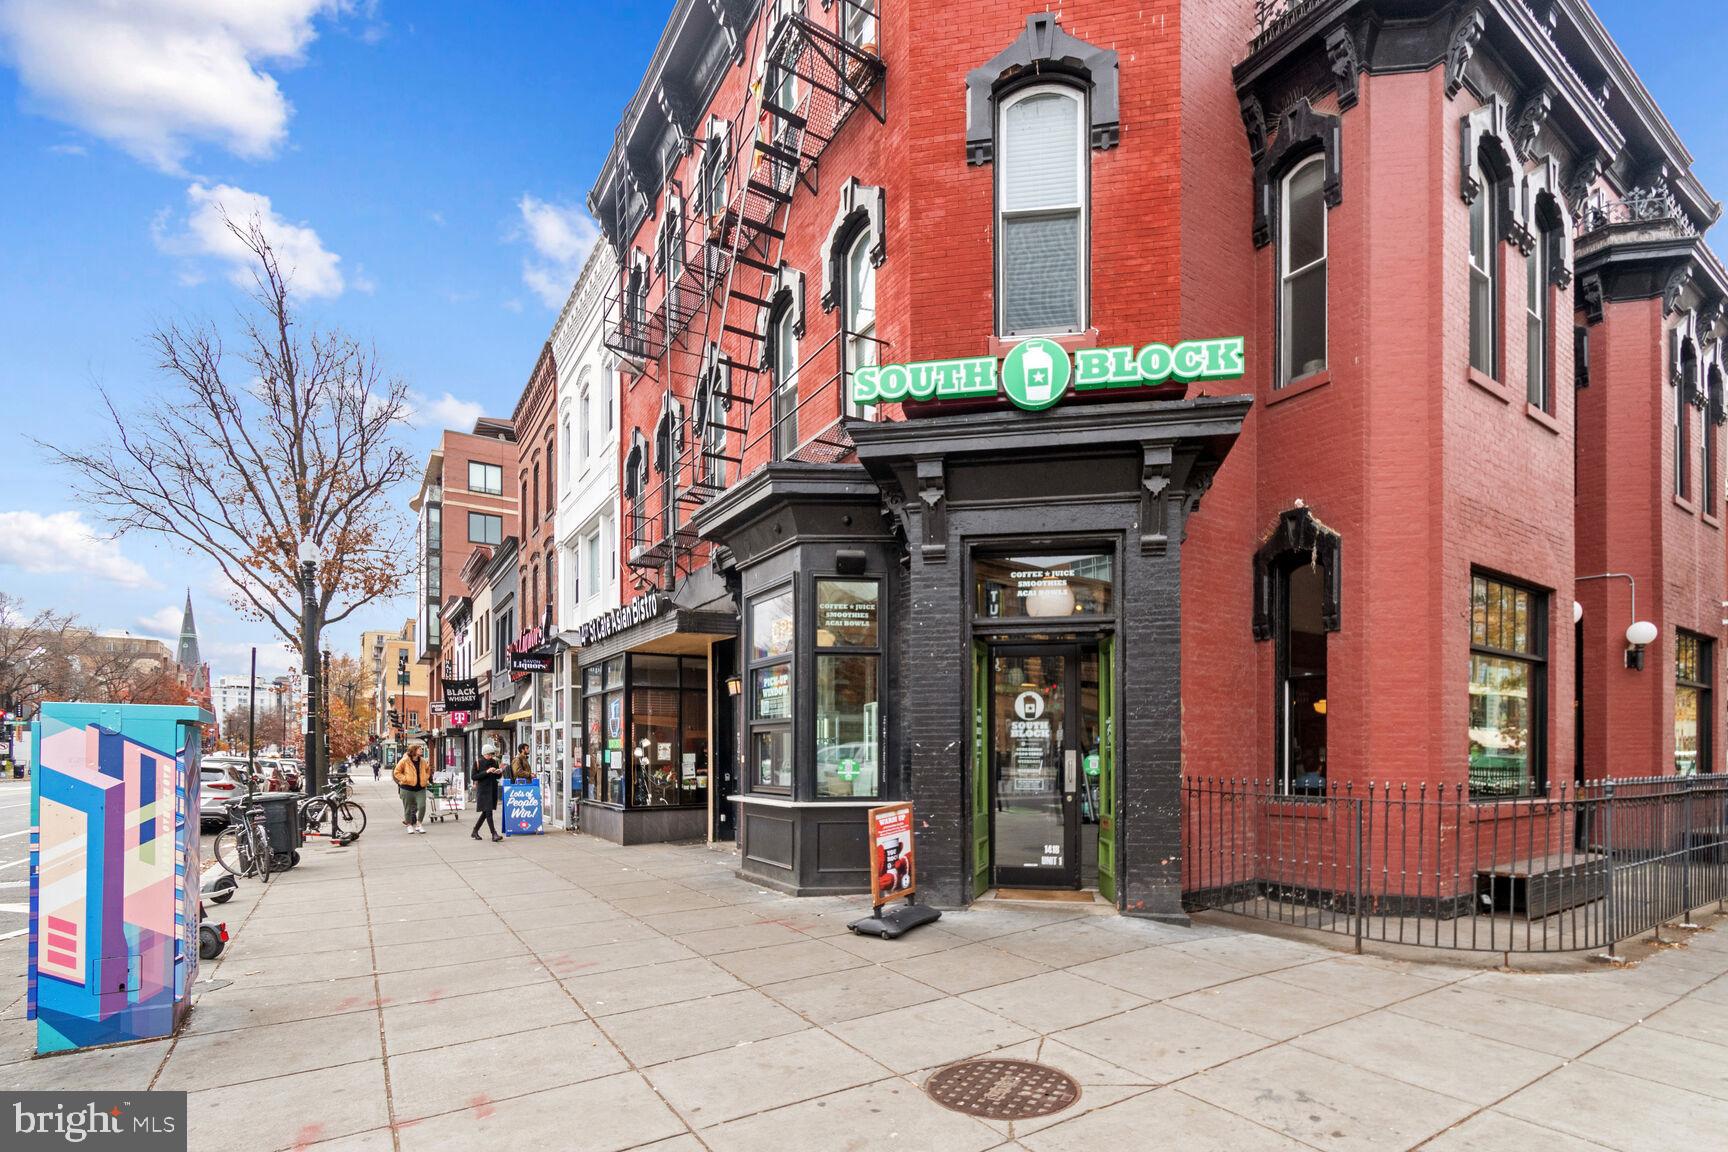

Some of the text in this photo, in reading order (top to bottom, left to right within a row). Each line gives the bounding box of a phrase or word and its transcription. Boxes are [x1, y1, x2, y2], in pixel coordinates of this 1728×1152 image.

[854, 337, 1243, 400] SOUTH BLOCK
[1010, 569, 1075, 578] COFFEE JUICE
[1018, 579, 1068, 587] SMOOTHIES
[611, 607, 632, 633] Asian
[632, 592, 657, 624] Bistro
[513, 661, 546, 670] Liquors
[446, 688, 476, 696] BLACK
[762, 685, 789, 698] WINDOW
[1011, 721, 1049, 730] SOUTH
[1010, 729, 1050, 737] BLOCK
[510, 789, 534, 800] Lots of
[506, 797, 538, 809] People
[511, 806, 538, 818] Win!
